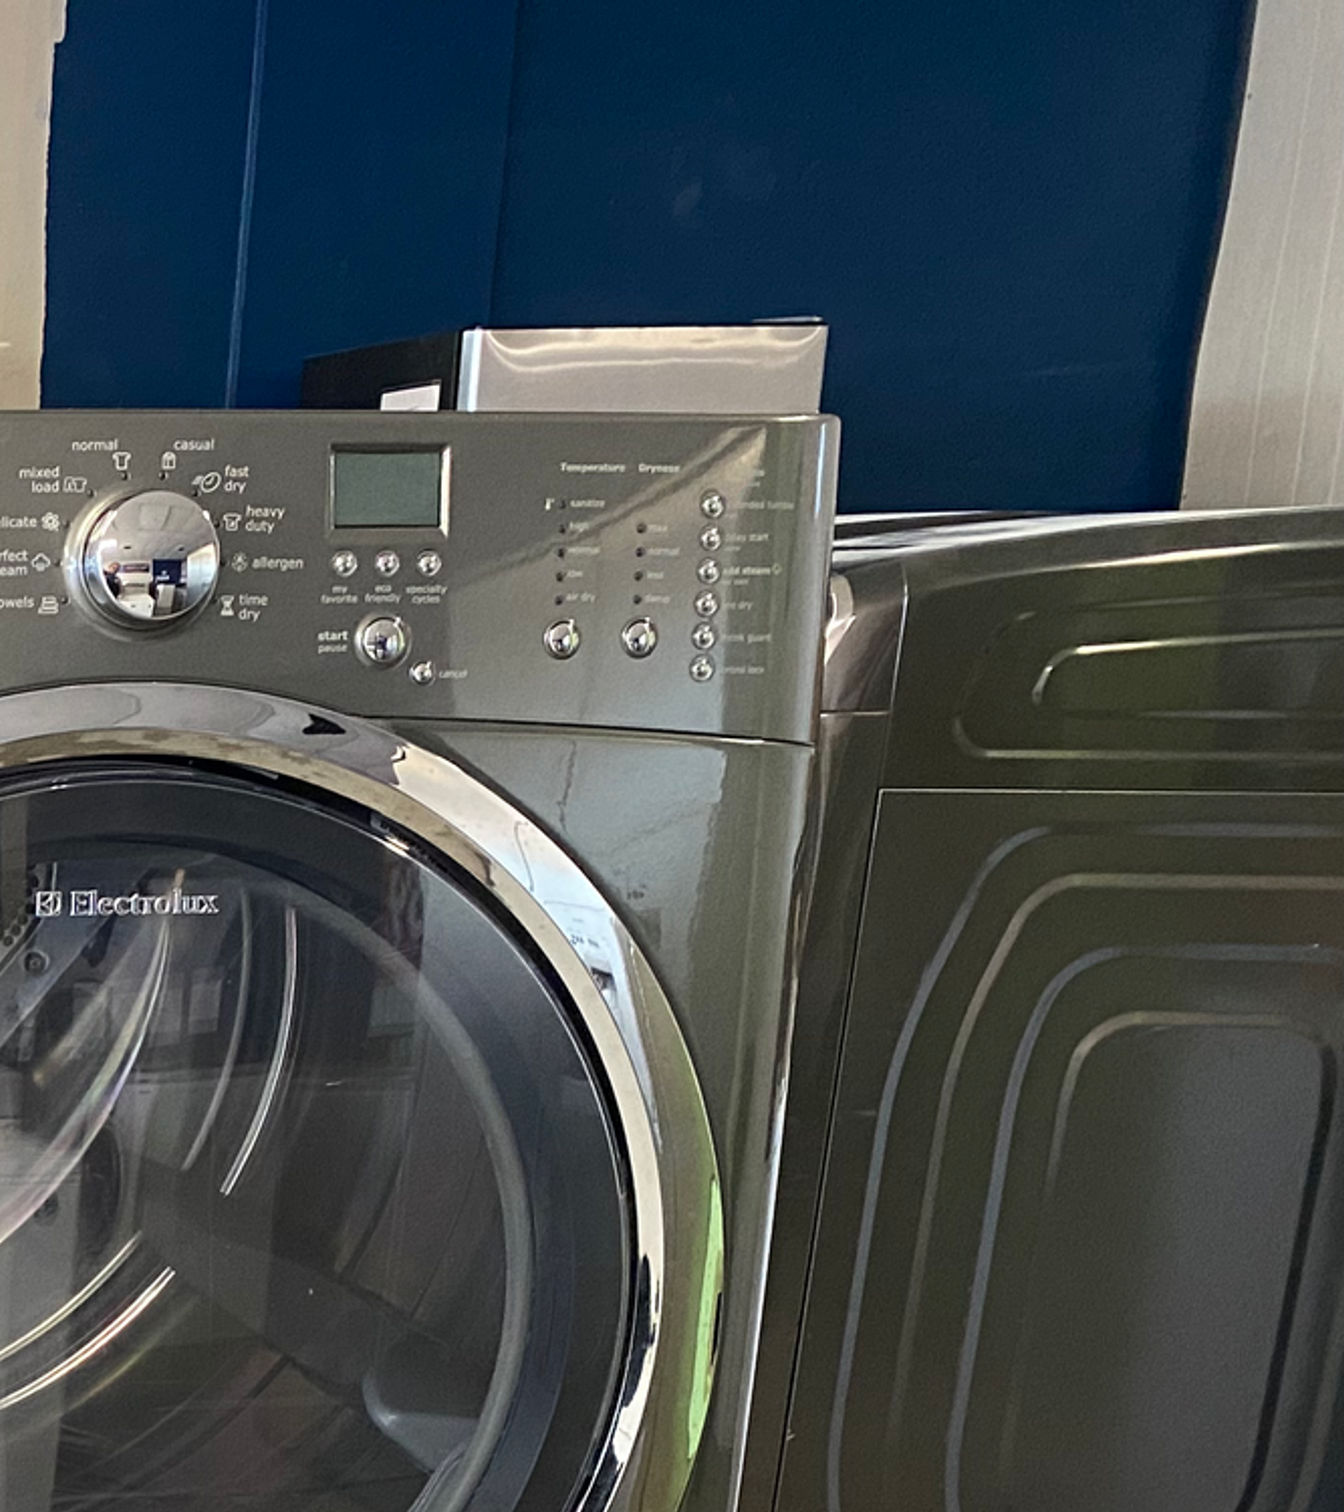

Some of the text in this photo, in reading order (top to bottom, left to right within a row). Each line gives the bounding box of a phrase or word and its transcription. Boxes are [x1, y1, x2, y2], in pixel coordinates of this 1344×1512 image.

[71, 438, 118, 451] normal
[174, 438, 215, 451] casual
[19, 466, 60, 479] mixed
[224, 464, 250, 478] fast
[560, 462, 626, 474] Temperature
[31, 479, 60, 493] load
[224, 478, 247, 494] dry
[245, 505, 285, 520] heavy
[245, 519, 276, 534] duty
[252, 556, 304, 572] allergen
[238, 593, 269, 607] time
[238, 606, 261, 622] dry
[317, 630, 349, 641] start
[70, 888, 220, 917] Electrolux
